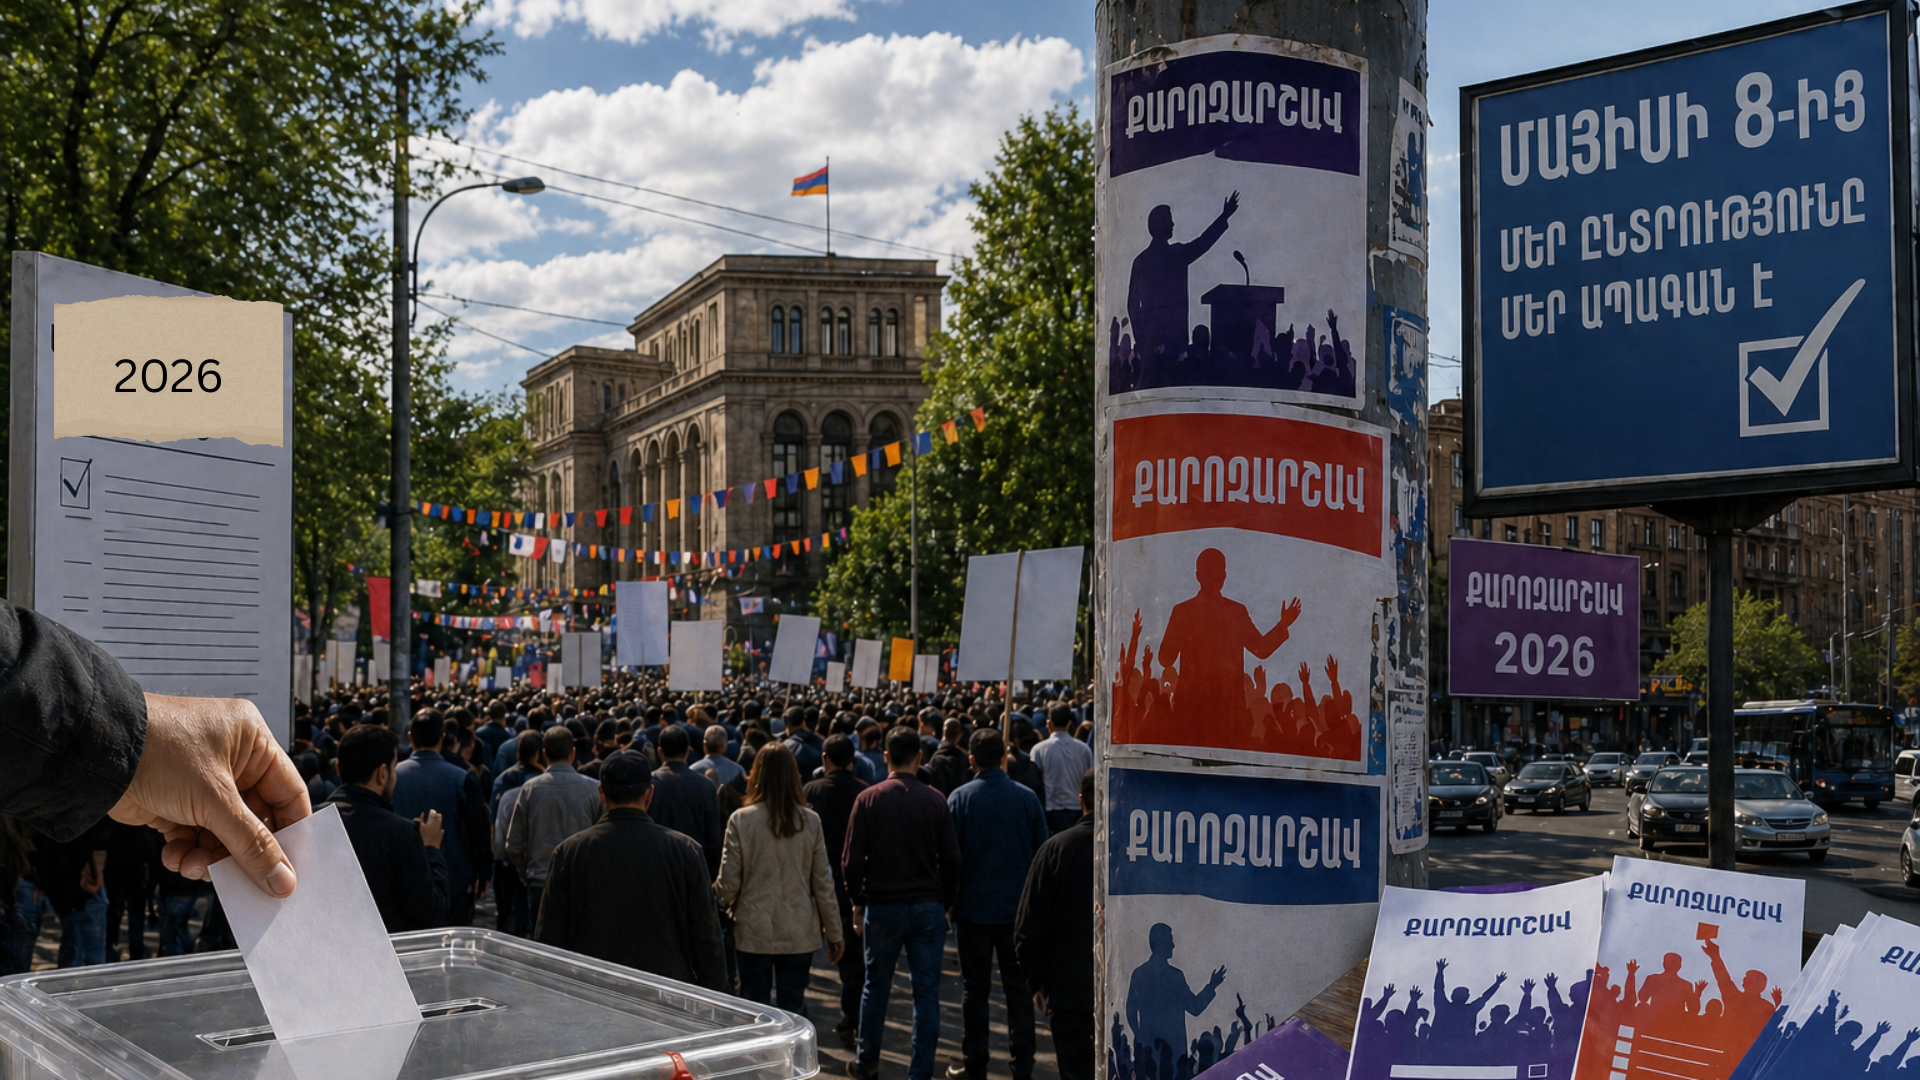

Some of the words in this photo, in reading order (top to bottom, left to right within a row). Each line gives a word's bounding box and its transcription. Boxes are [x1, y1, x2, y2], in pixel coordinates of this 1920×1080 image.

[1125, 79, 1343, 139] ՔԱՐՈԶԱՐՇԱՎ
[1500, 91, 1709, 187] ՄԱՅԻՍԻ
[1734, 69, 1866, 149] 8-ԻՑ
[1500, 220, 1566, 273] ՄԵՐ
[1580, 176, 1866, 262] ԸՆՏՐՈՒԹՅՈՒՆԸ
[1501, 289, 1566, 340] ՄԵՐ
[1581, 267, 1736, 330] ԱՊԱԳԱՆ
[1753, 262, 1774, 309] Է
[1132, 455, 1366, 514] ՔԱՐՈԶԱՐՇԱՎ
[1465, 571, 1624, 616] ՔԱՐՈԶԱՐՇԱՎ
[1494, 631, 1595, 677] 2026
[1126, 808, 1361, 869] ՔԱՐՈԶԱՐՇԱՎ
[1627, 882, 1783, 924] ՔԱՐՈԶԱՐՇԱՎ
